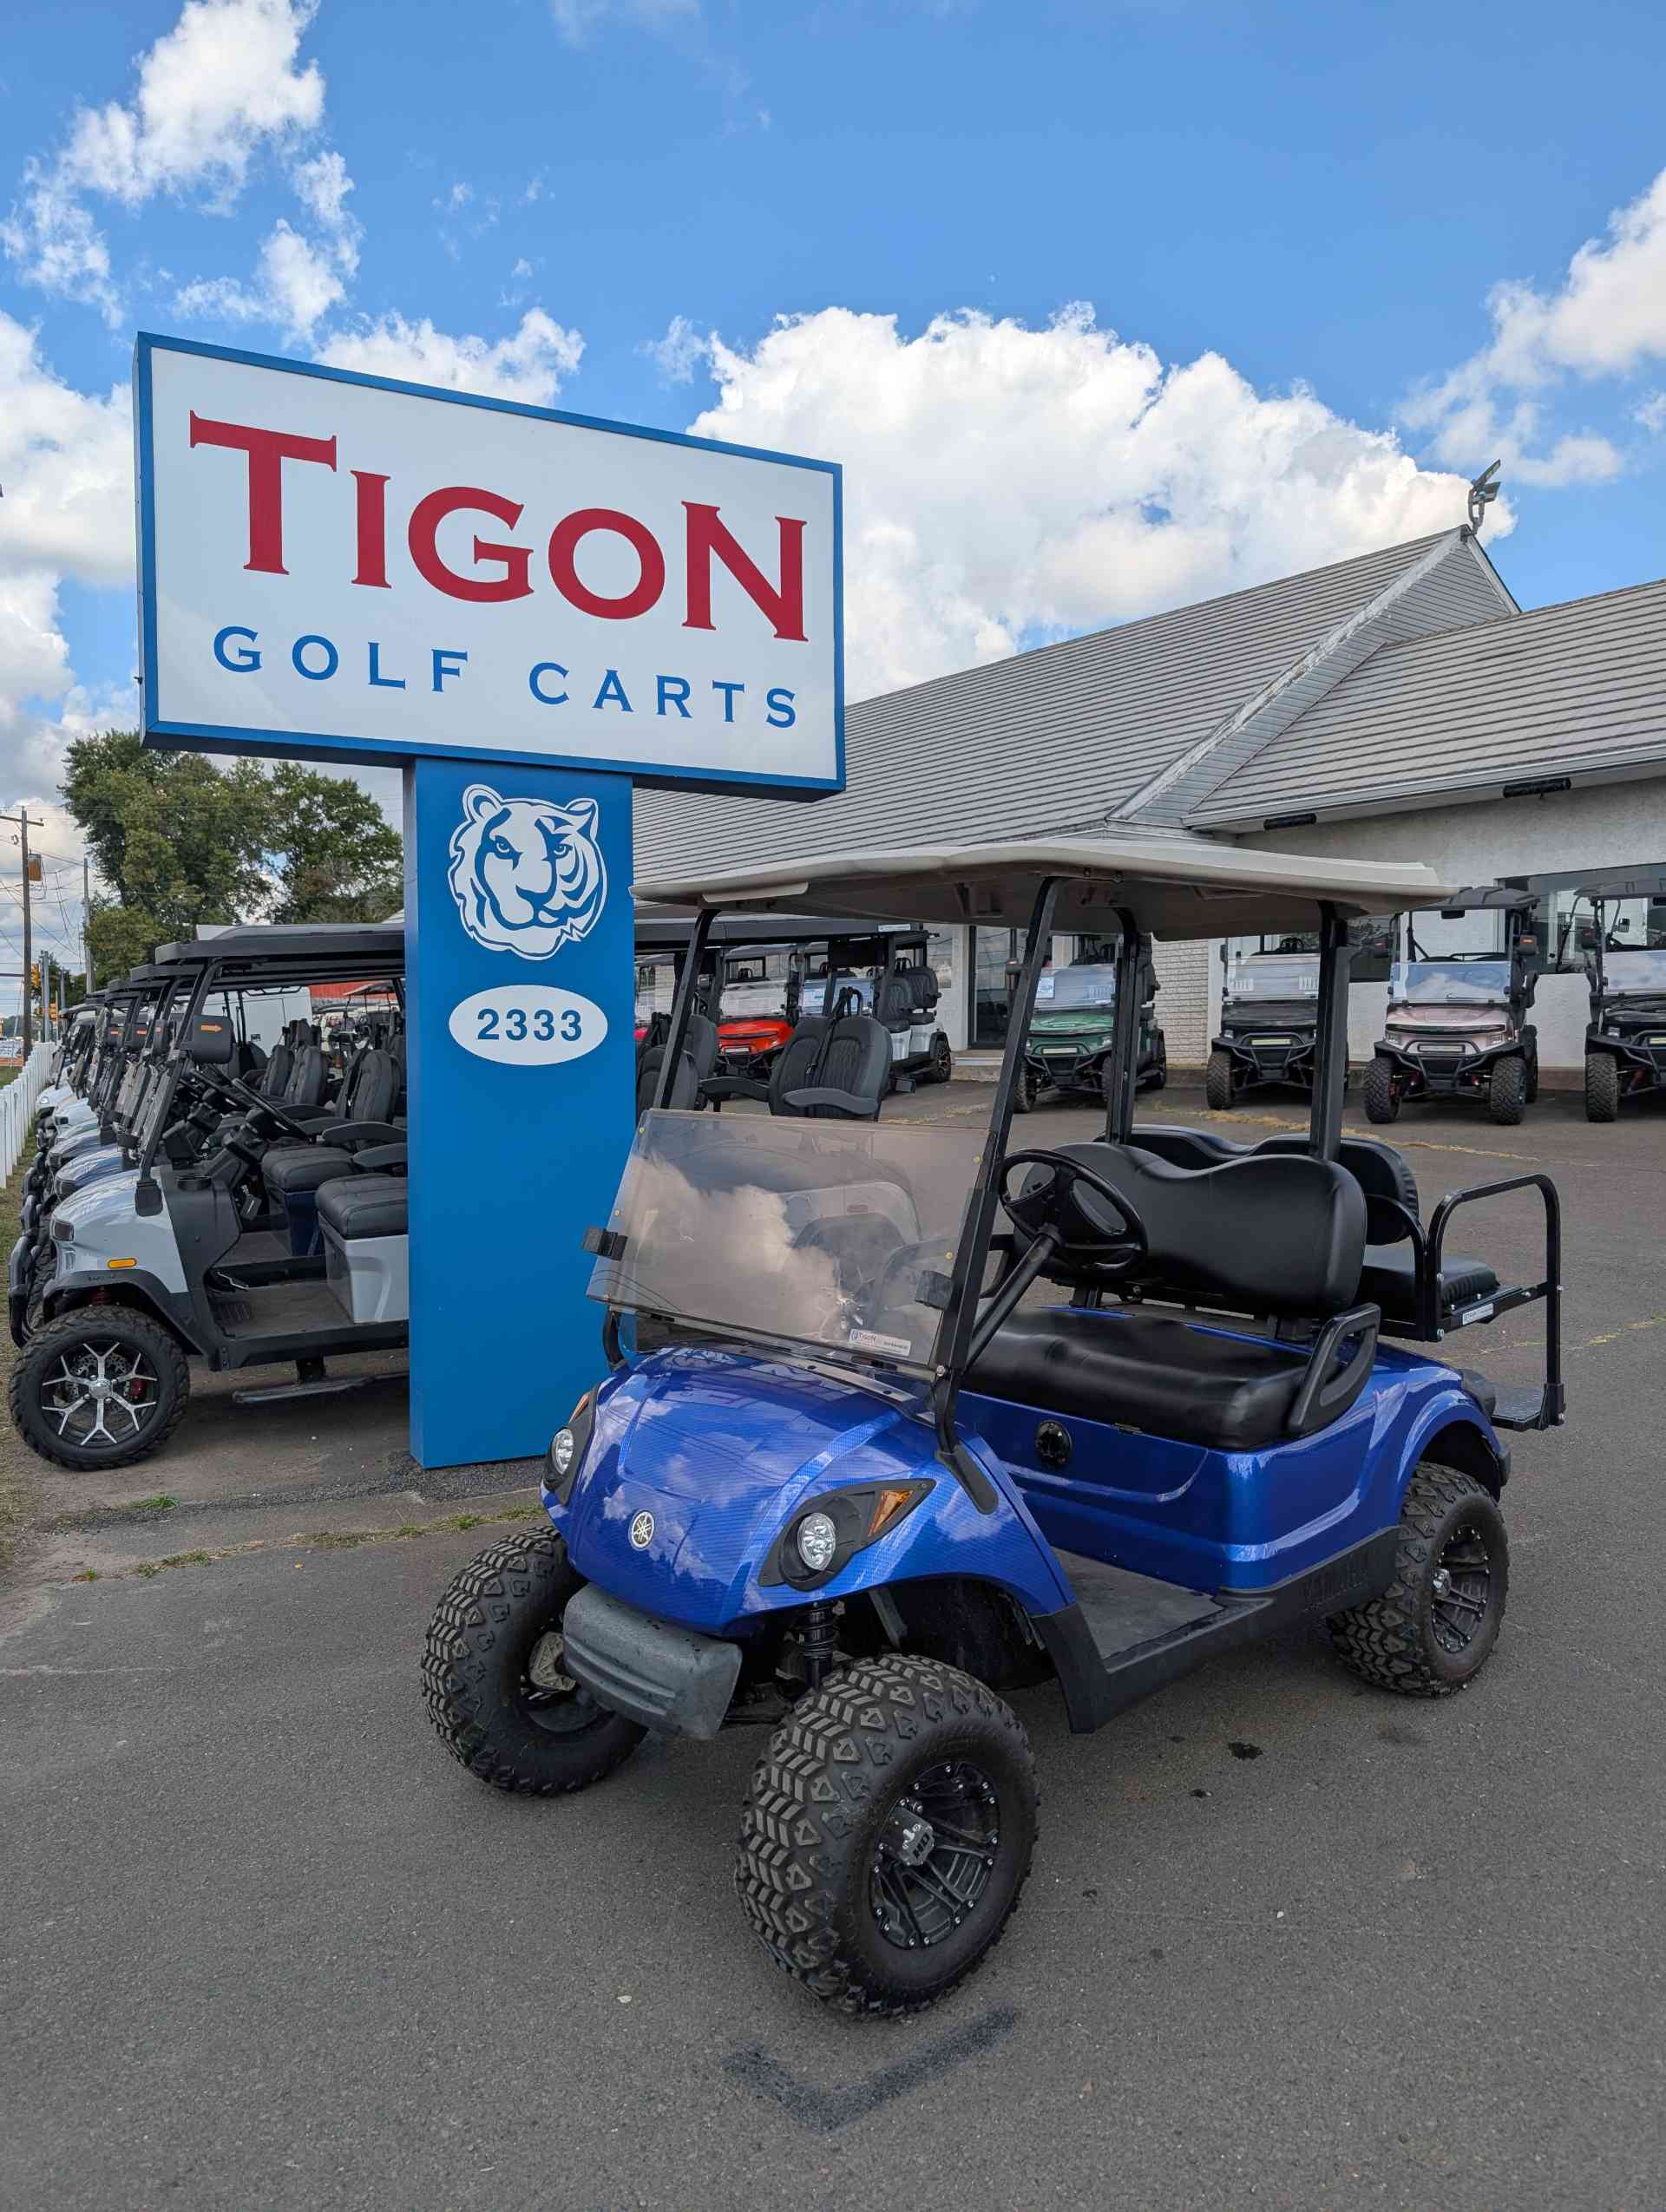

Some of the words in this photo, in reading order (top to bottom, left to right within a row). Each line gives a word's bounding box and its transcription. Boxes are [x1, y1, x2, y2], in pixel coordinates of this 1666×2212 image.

[189, 409, 809, 642] TIGON
[213, 625, 469, 693] GOLF
[528, 661, 798, 729] CARTS
[476, 1008, 582, 1042] 2333
